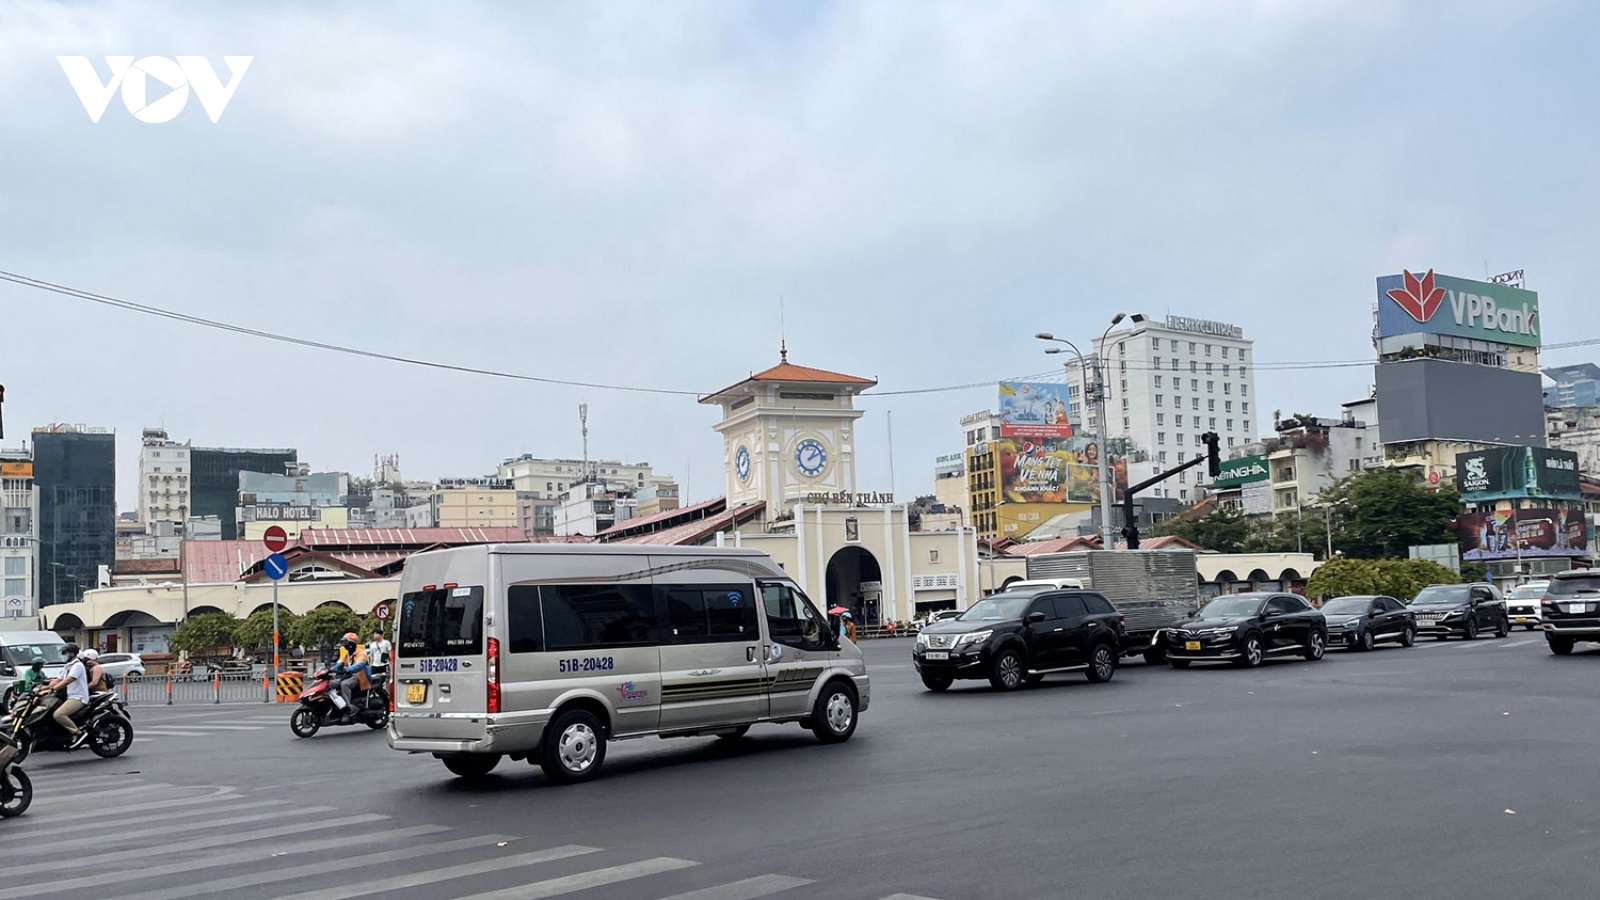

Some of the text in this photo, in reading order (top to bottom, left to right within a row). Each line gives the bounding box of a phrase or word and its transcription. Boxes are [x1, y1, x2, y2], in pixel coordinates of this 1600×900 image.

[1448, 290, 1537, 337] VPBank
[1014, 455, 1044, 469] MANG
[807, 489, 894, 505] CHỢ BẾN THÀNH
[257, 507, 310, 519] HALO HOTEL
[420, 658, 458, 672] 51B-20428
[560, 656, 614, 672] 51B-20428
